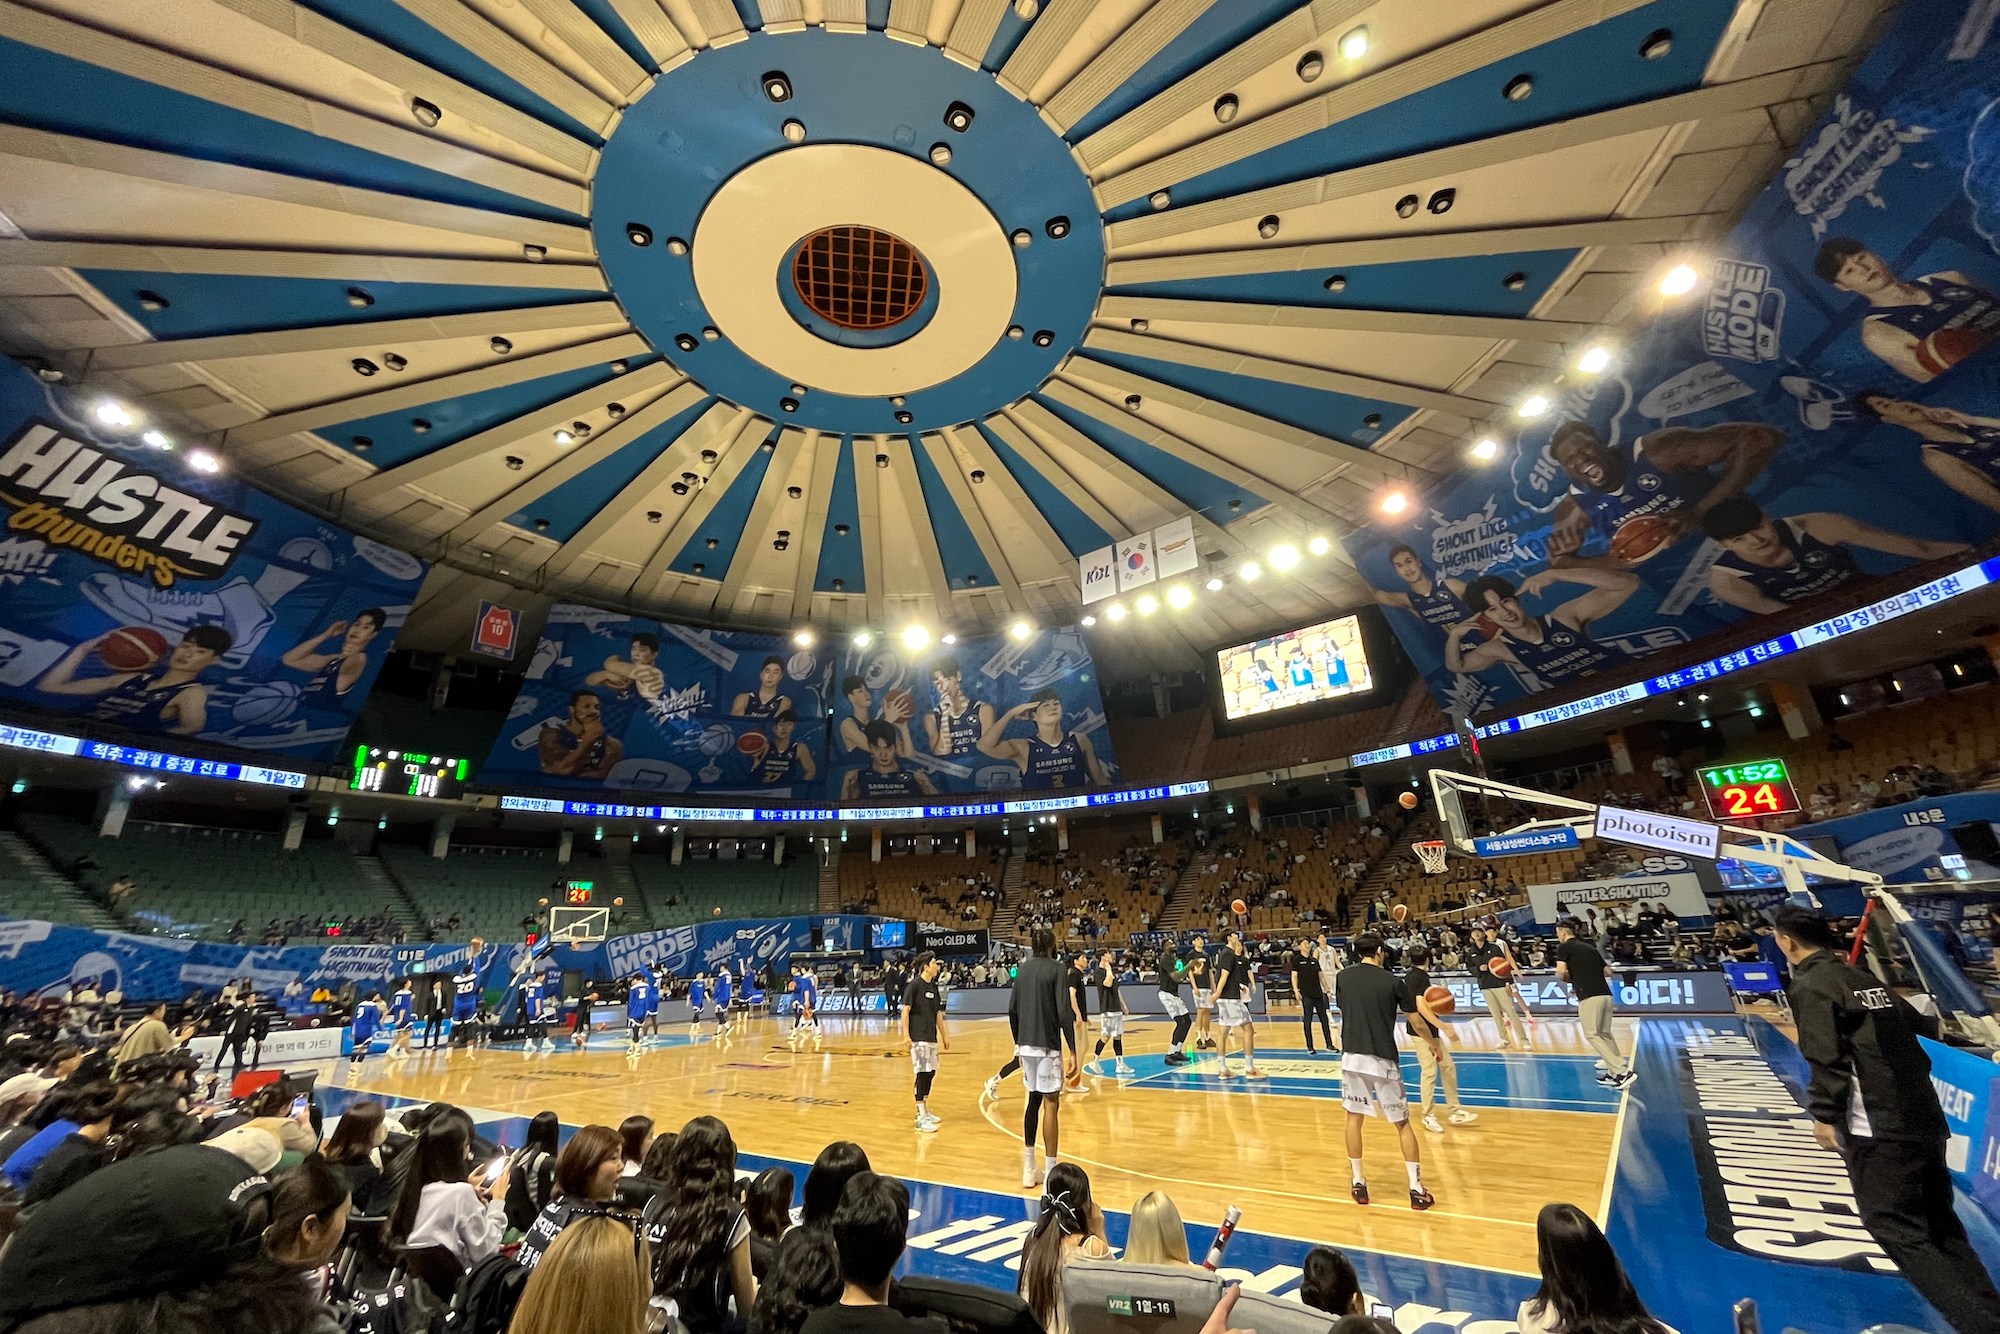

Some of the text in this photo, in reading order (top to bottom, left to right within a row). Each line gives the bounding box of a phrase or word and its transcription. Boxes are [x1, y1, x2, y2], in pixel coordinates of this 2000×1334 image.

[1706, 263, 1736, 354] HUSTLE
[1728, 268, 1765, 358] MODE
[0, 424, 253, 566] HUSTLE
[1612, 493, 1667, 526] SAMSUNG
[8, 502, 178, 587] thunders
[1436, 520, 1508, 551] SHOUT LIKE
[491, 624, 503, 636] 10
[1537, 648, 1590, 672] SAMSUNG
[1656, 641, 1784, 690] 척추·관절 중점 진료
[1488, 721, 1511, 737] 진료
[1418, 733, 1460, 752] 척추·관
[92, 743, 229, 777] 척추·관절 중점 진료
[1035, 757, 1073, 768] SAMSUNG
[258, 770, 307, 788] 제일정
[1706, 763, 1785, 787] 11:52
[1723, 784, 1779, 815] 24
[1486, 832, 1568, 852] 서울삼성썬더스농구단
[1602, 814, 1712, 848] photoism
[1642, 855, 1688, 873] S5
[569, 889, 588, 902] 24
[735, 928, 755, 940] S3
[925, 933, 977, 947] Neo QLED 8K
[329, 944, 392, 958] SHOUT LIKE
[612, 930, 696, 978] MODE
[324, 960, 389, 975] LIGHTNING!
[456, 981, 474, 994] 20
[1689, 1058, 1806, 1114] SAMSUNG
[1929, 1074, 1975, 1122] WEAT
[1704, 1116, 1900, 1271] THUNDERS
[1109, 1299, 1171, 1314] VR2 1열-16
